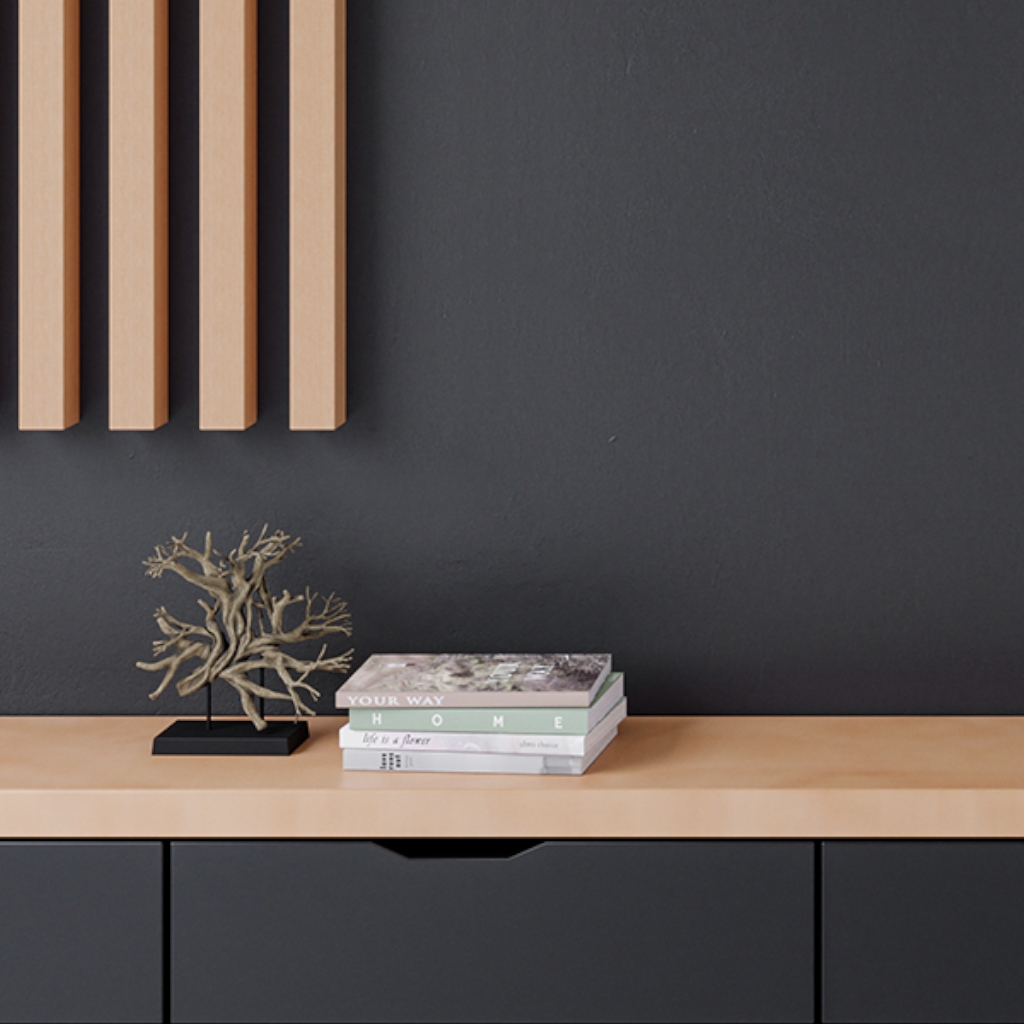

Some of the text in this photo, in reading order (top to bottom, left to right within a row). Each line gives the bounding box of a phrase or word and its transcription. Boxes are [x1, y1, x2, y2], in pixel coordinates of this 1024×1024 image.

[347, 695, 445, 706] YOUR WAY
[362, 732, 379, 747] life
